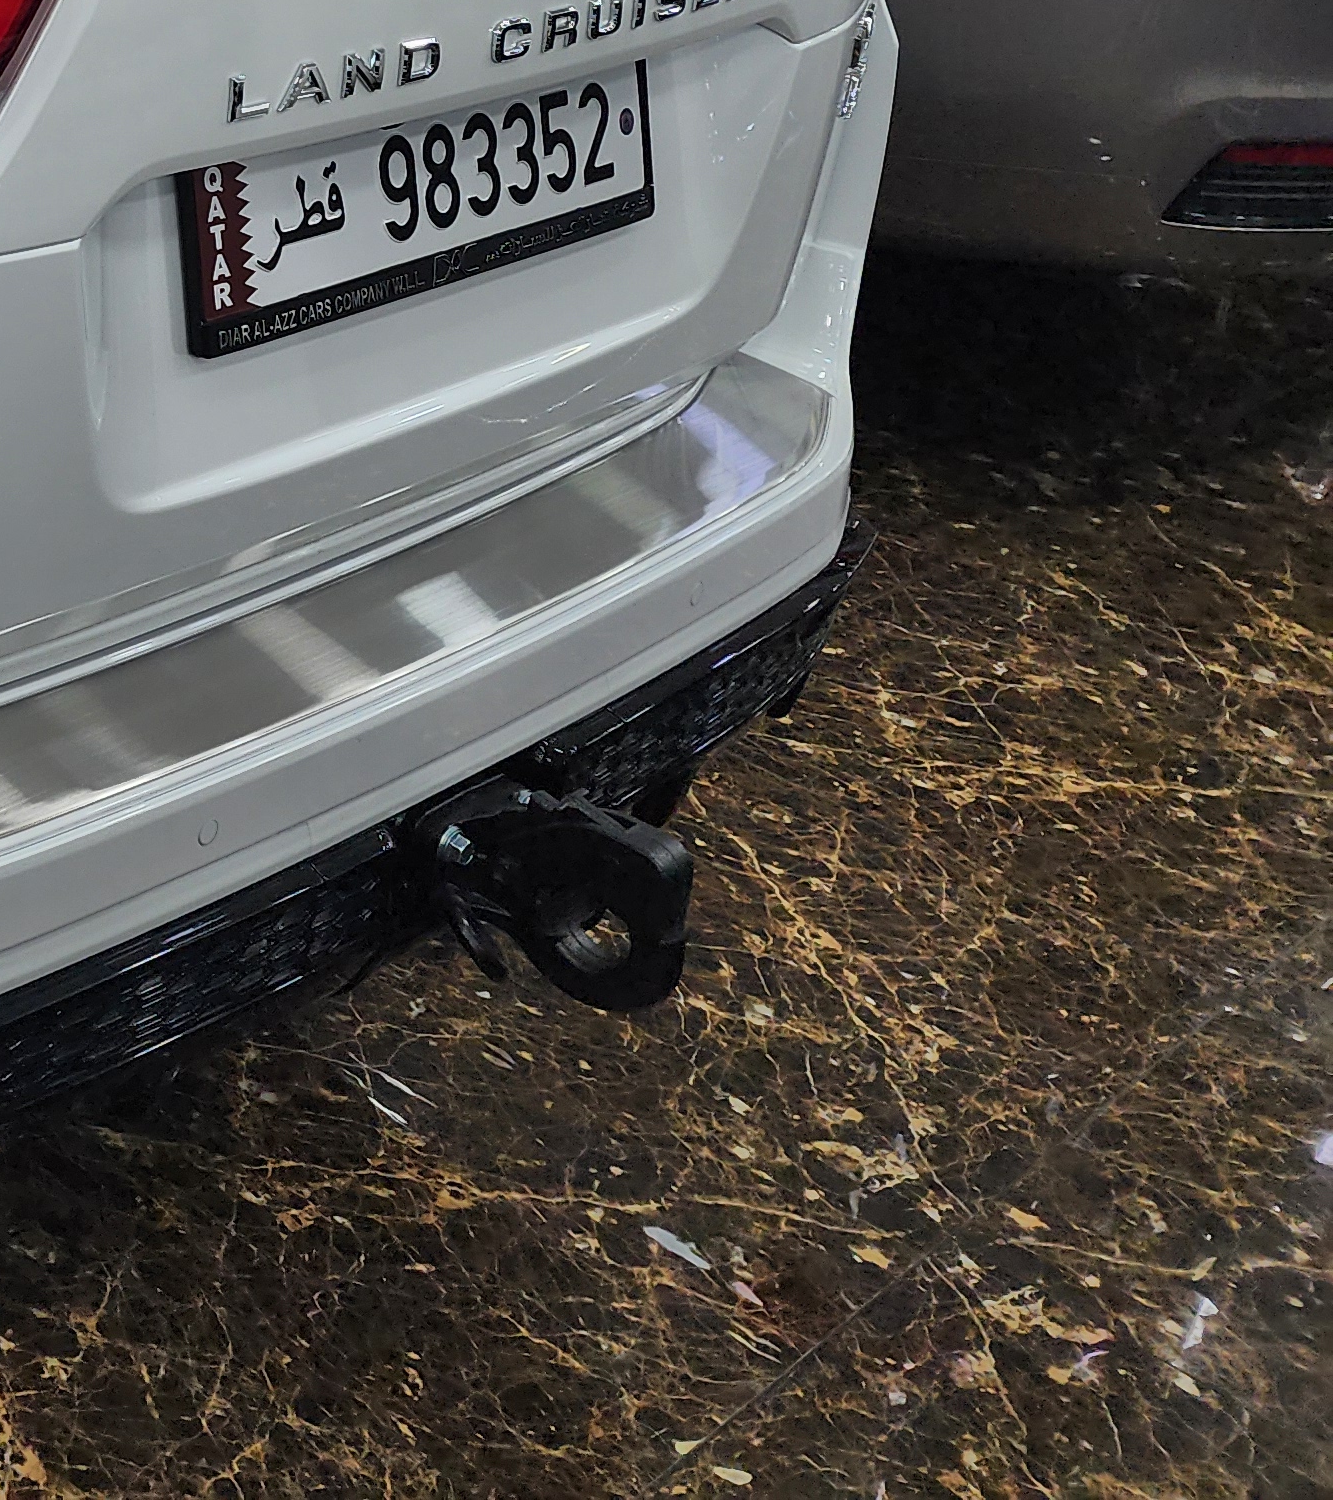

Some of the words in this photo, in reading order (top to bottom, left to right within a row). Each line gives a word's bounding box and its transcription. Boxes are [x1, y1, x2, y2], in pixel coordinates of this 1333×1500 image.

[227, 36, 442, 124] LAND
[255, 160, 345, 272] قطر
[378, 80, 616, 243] 983352
[202, 166, 234, 311] QATAR
[218, 324, 252, 350] DIAR
[299, 297, 333, 326] CARS
[335, 278, 391, 314] COMPANY
